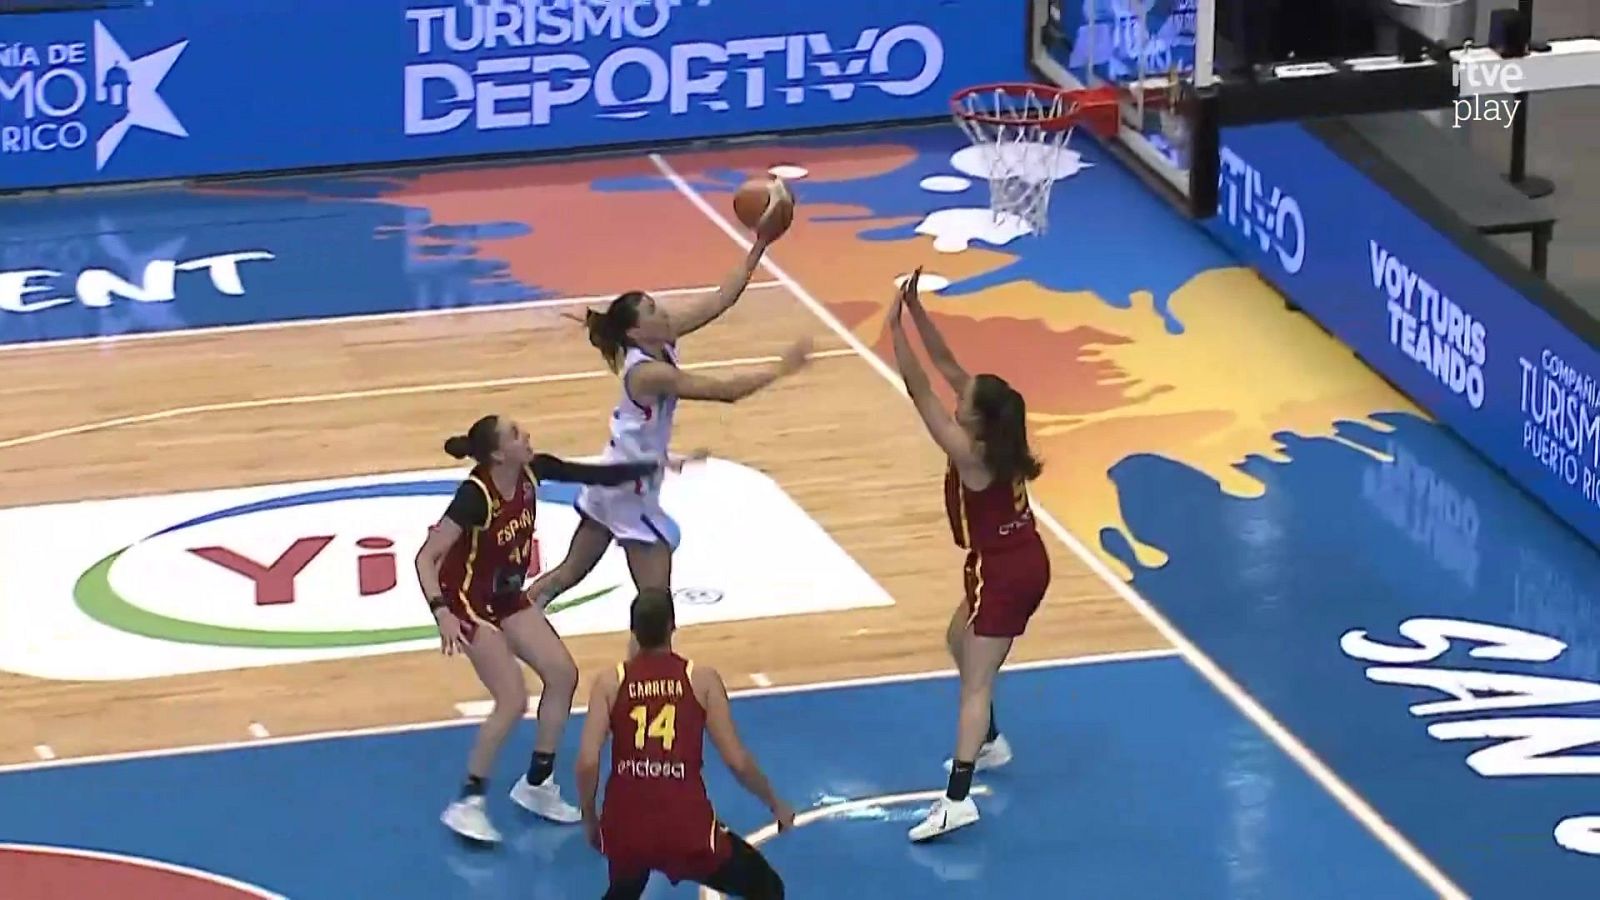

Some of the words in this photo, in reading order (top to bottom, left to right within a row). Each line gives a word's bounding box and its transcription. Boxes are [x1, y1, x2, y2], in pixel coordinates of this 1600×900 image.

[48, 42, 87, 64] DE
[405, 0, 671, 54] TURISMO
[404, 24, 944, 136] DEPORTIVO
[2, 121, 88, 152] RICO
[1217, 146, 1305, 273] TIVO
[0, 250, 276, 312] ENT
[1387, 299, 1485, 409] TEANDO
[1519, 357, 1600, 468] TURISM
[1522, 420, 1577, 484] PUERTO
[629, 702, 676, 751] 14
[1340, 616, 1600, 777] SAN
